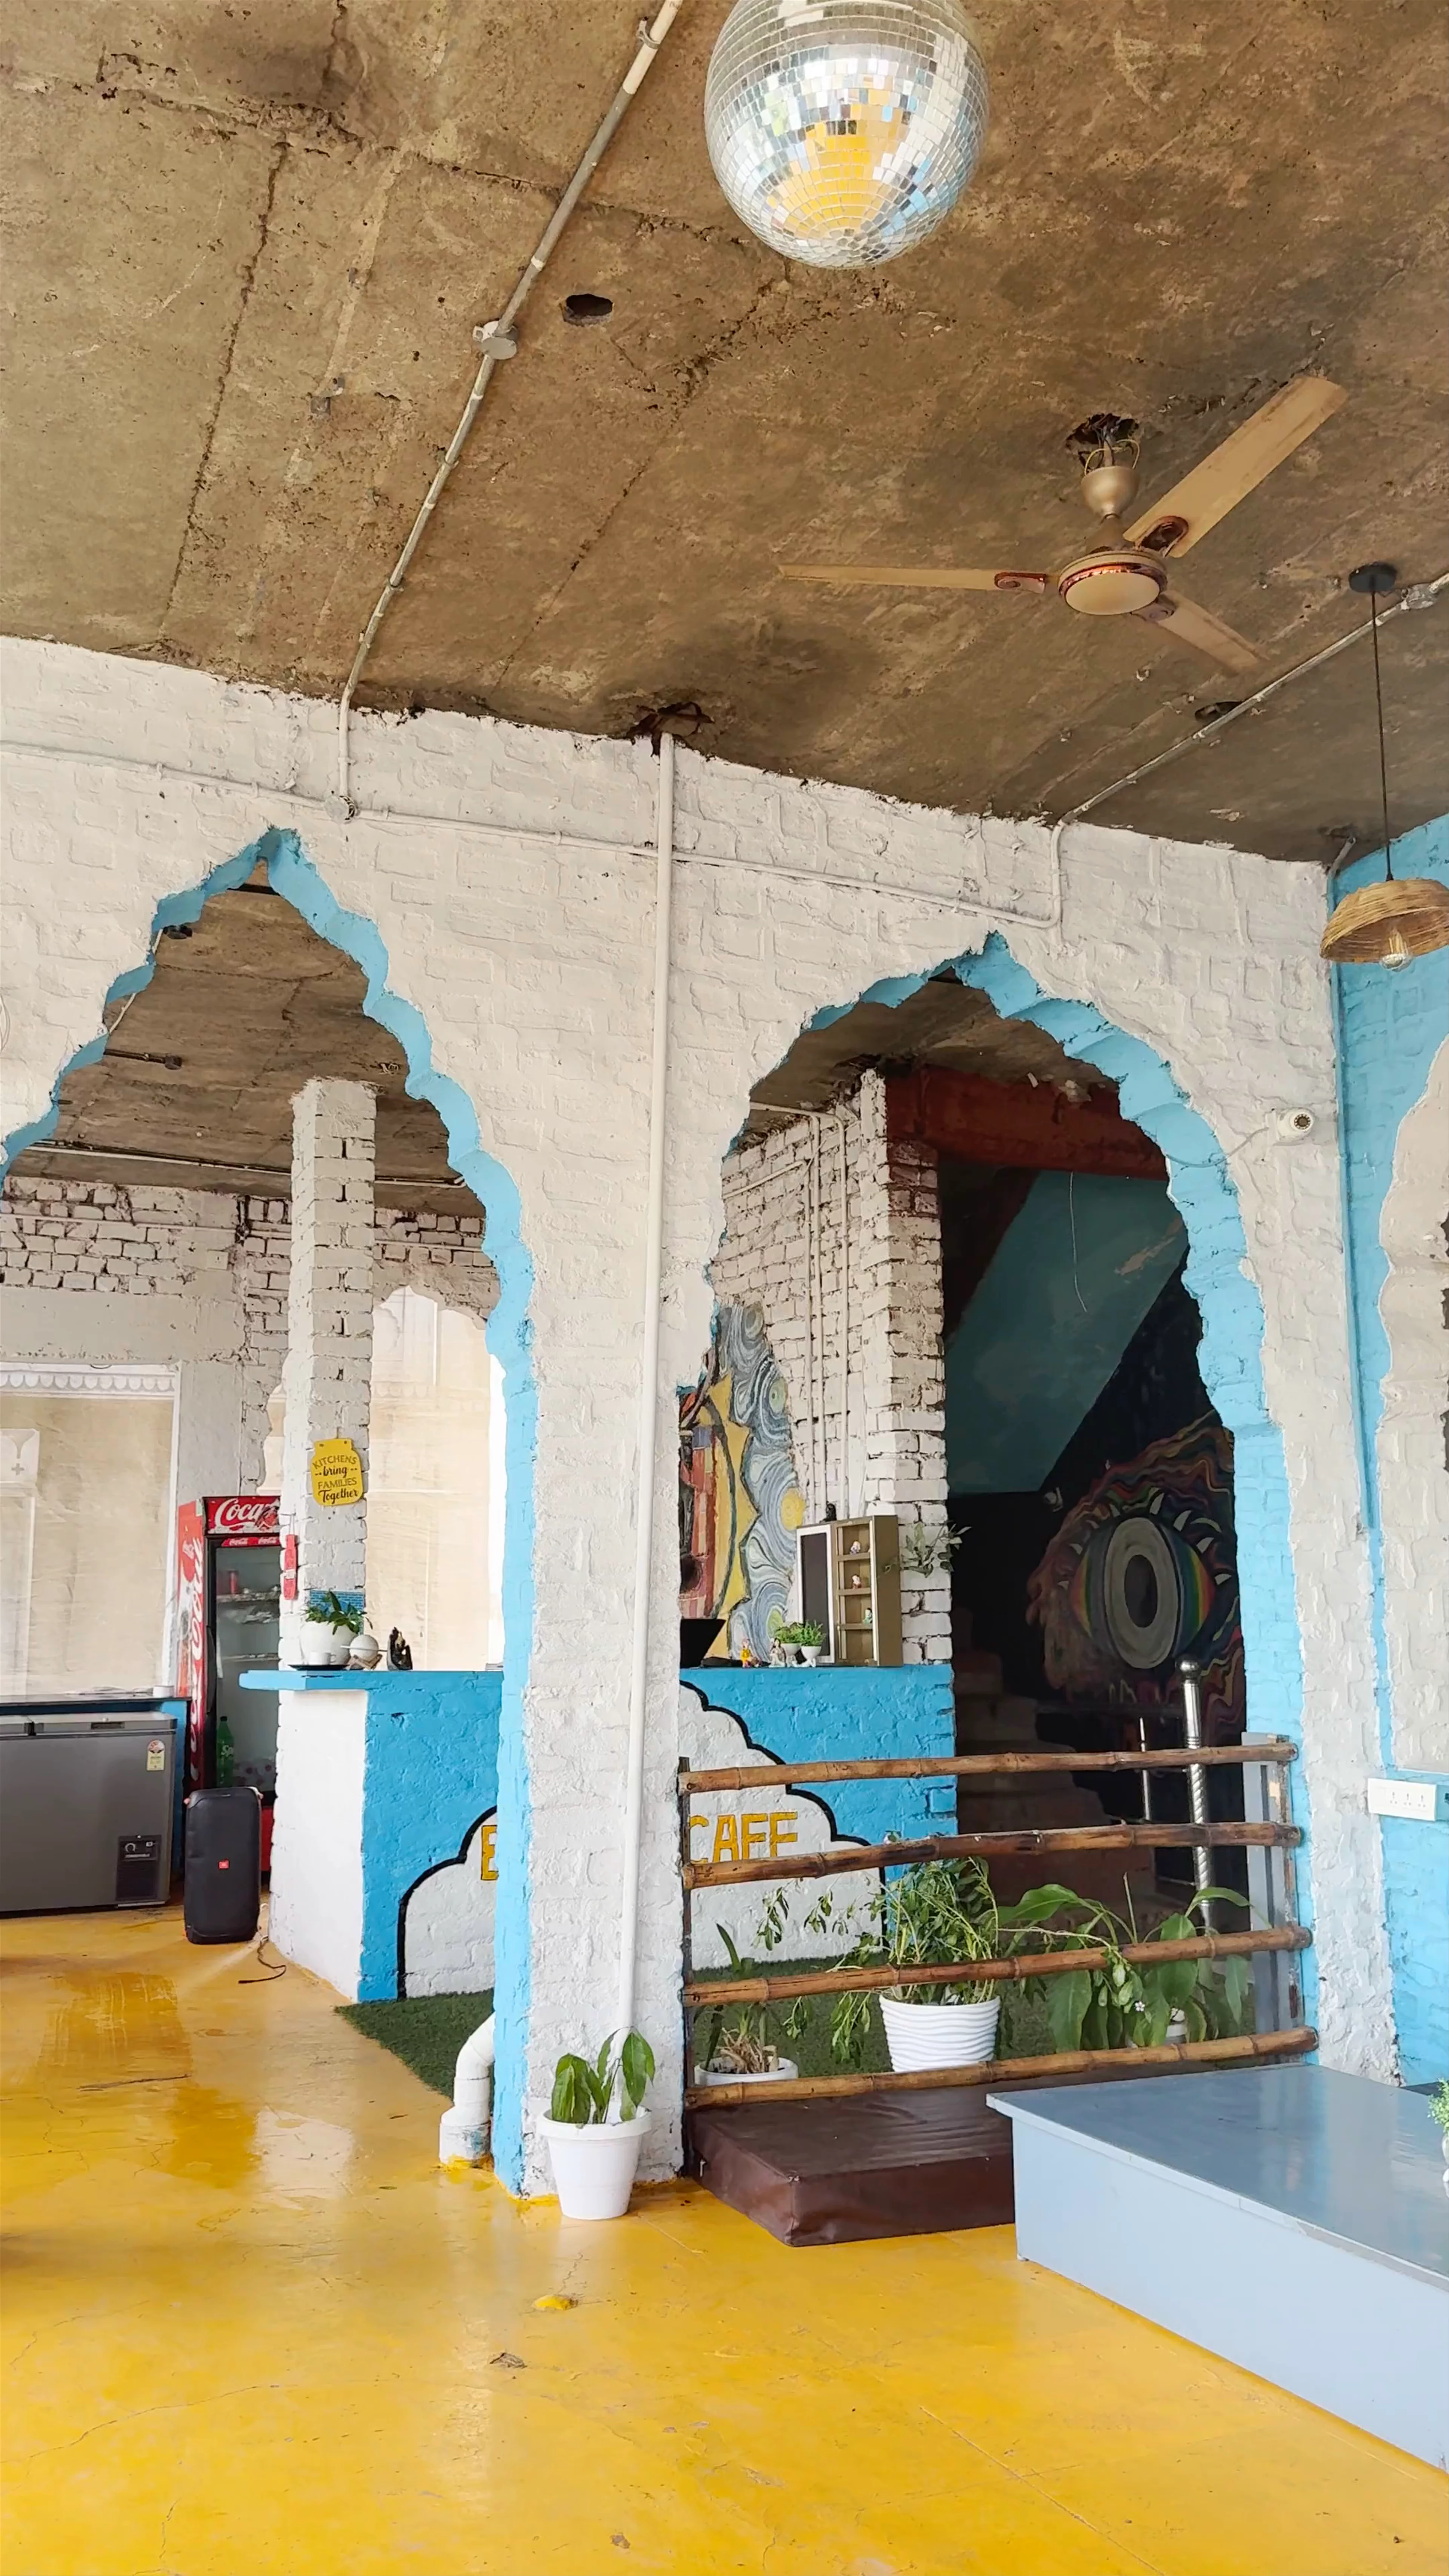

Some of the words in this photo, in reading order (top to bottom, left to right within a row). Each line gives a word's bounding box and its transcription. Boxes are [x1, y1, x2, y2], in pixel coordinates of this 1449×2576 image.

[312, 1455, 357, 1469] KITCHENS
[323, 1465, 347, 1478] bring
[318, 1477, 357, 1489] FAMILIES
[318, 1488, 358, 1504] Together
